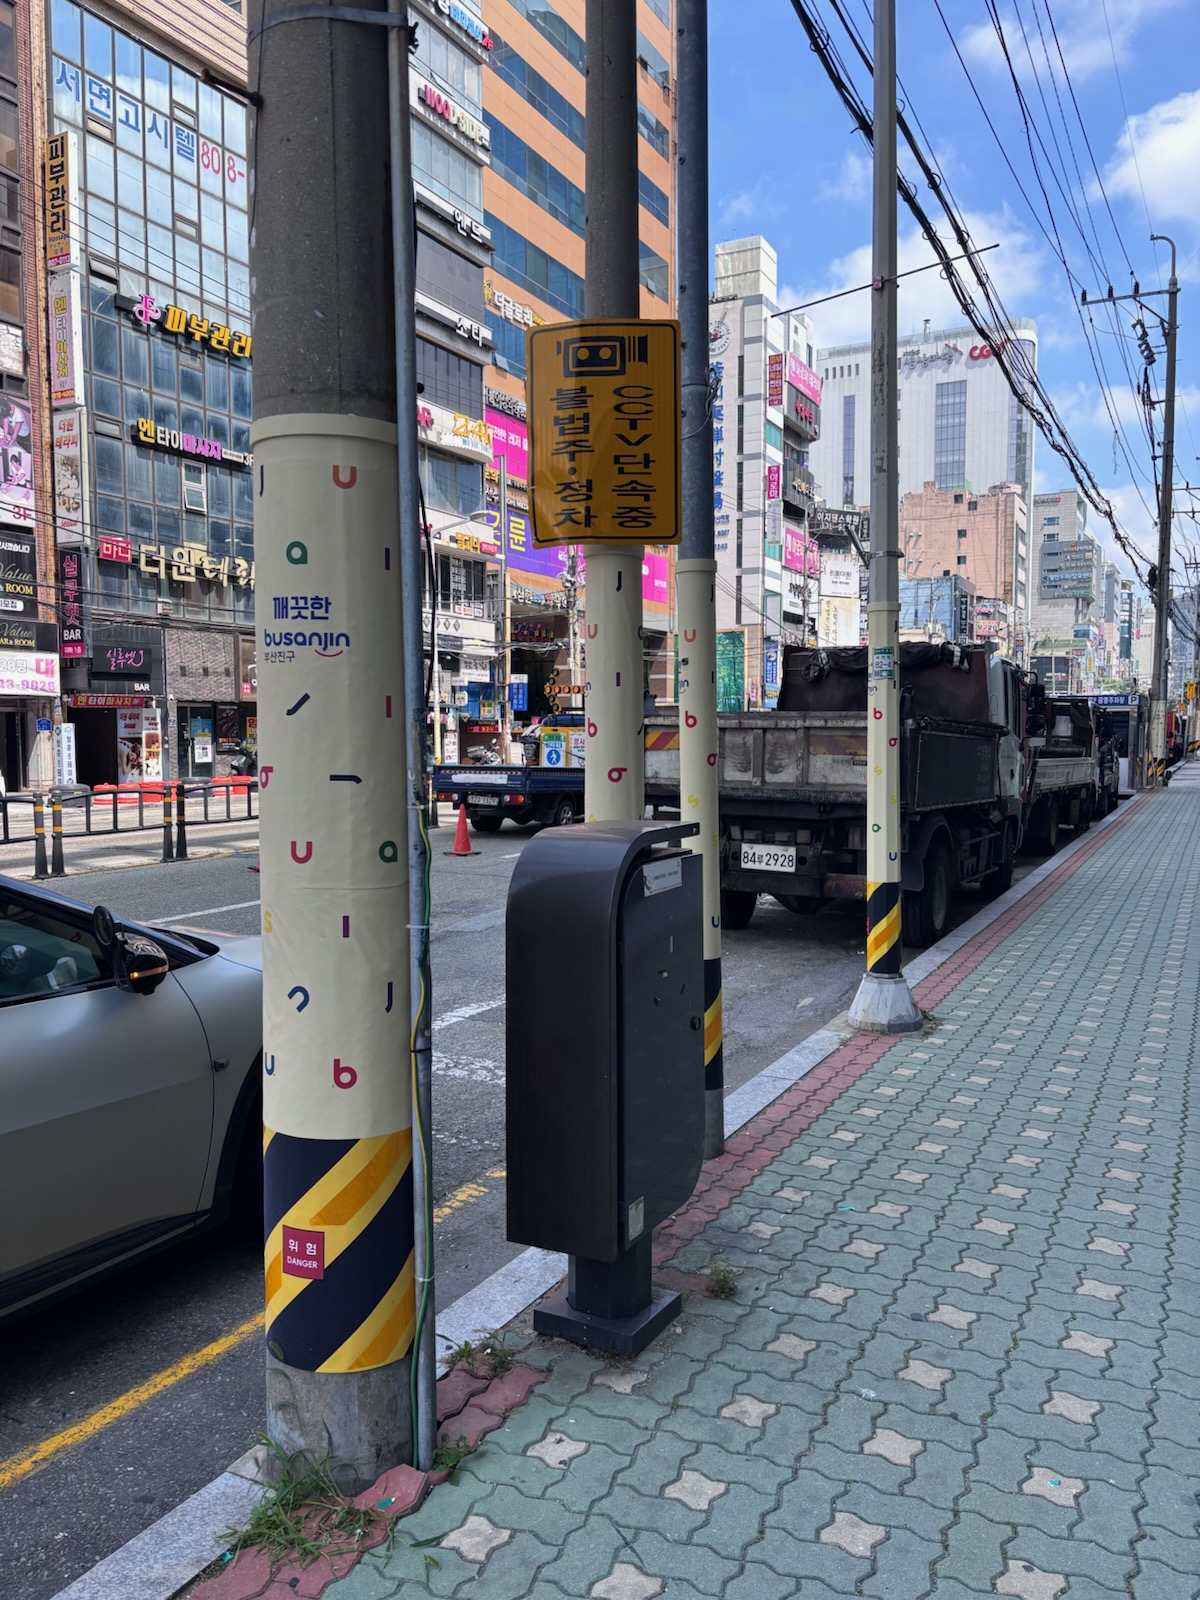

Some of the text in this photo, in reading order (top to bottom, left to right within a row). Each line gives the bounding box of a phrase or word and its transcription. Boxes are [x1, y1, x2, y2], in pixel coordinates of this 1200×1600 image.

[55, 61, 195, 163] 서면고시텔
[48, 135, 67, 233] 피부관리
[165, 304, 252, 358] 피부관리
[138, 418, 221, 460] 엔타이마사지
[550, 386, 598, 528] 불법주·정차
[12, 504, 32, 521] 3F
[5, 583, 33, 595] ROOM
[63, 555, 79, 626] 실루엣
[273, 596, 332, 620] 깨끗한
[0, 622, 34, 638] Value
[64, 628, 81, 641] BAR
[14, 639, 35, 647] ROOM
[264, 629, 350, 651] busanjin
[107, 648, 144, 671] 실루엣
[264, 651, 296, 664] 부산진구
[134, 683, 150, 692] BAR
[743, 851, 794, 868] 84루2928
[286, 1255, 318, 1269] DANGER
